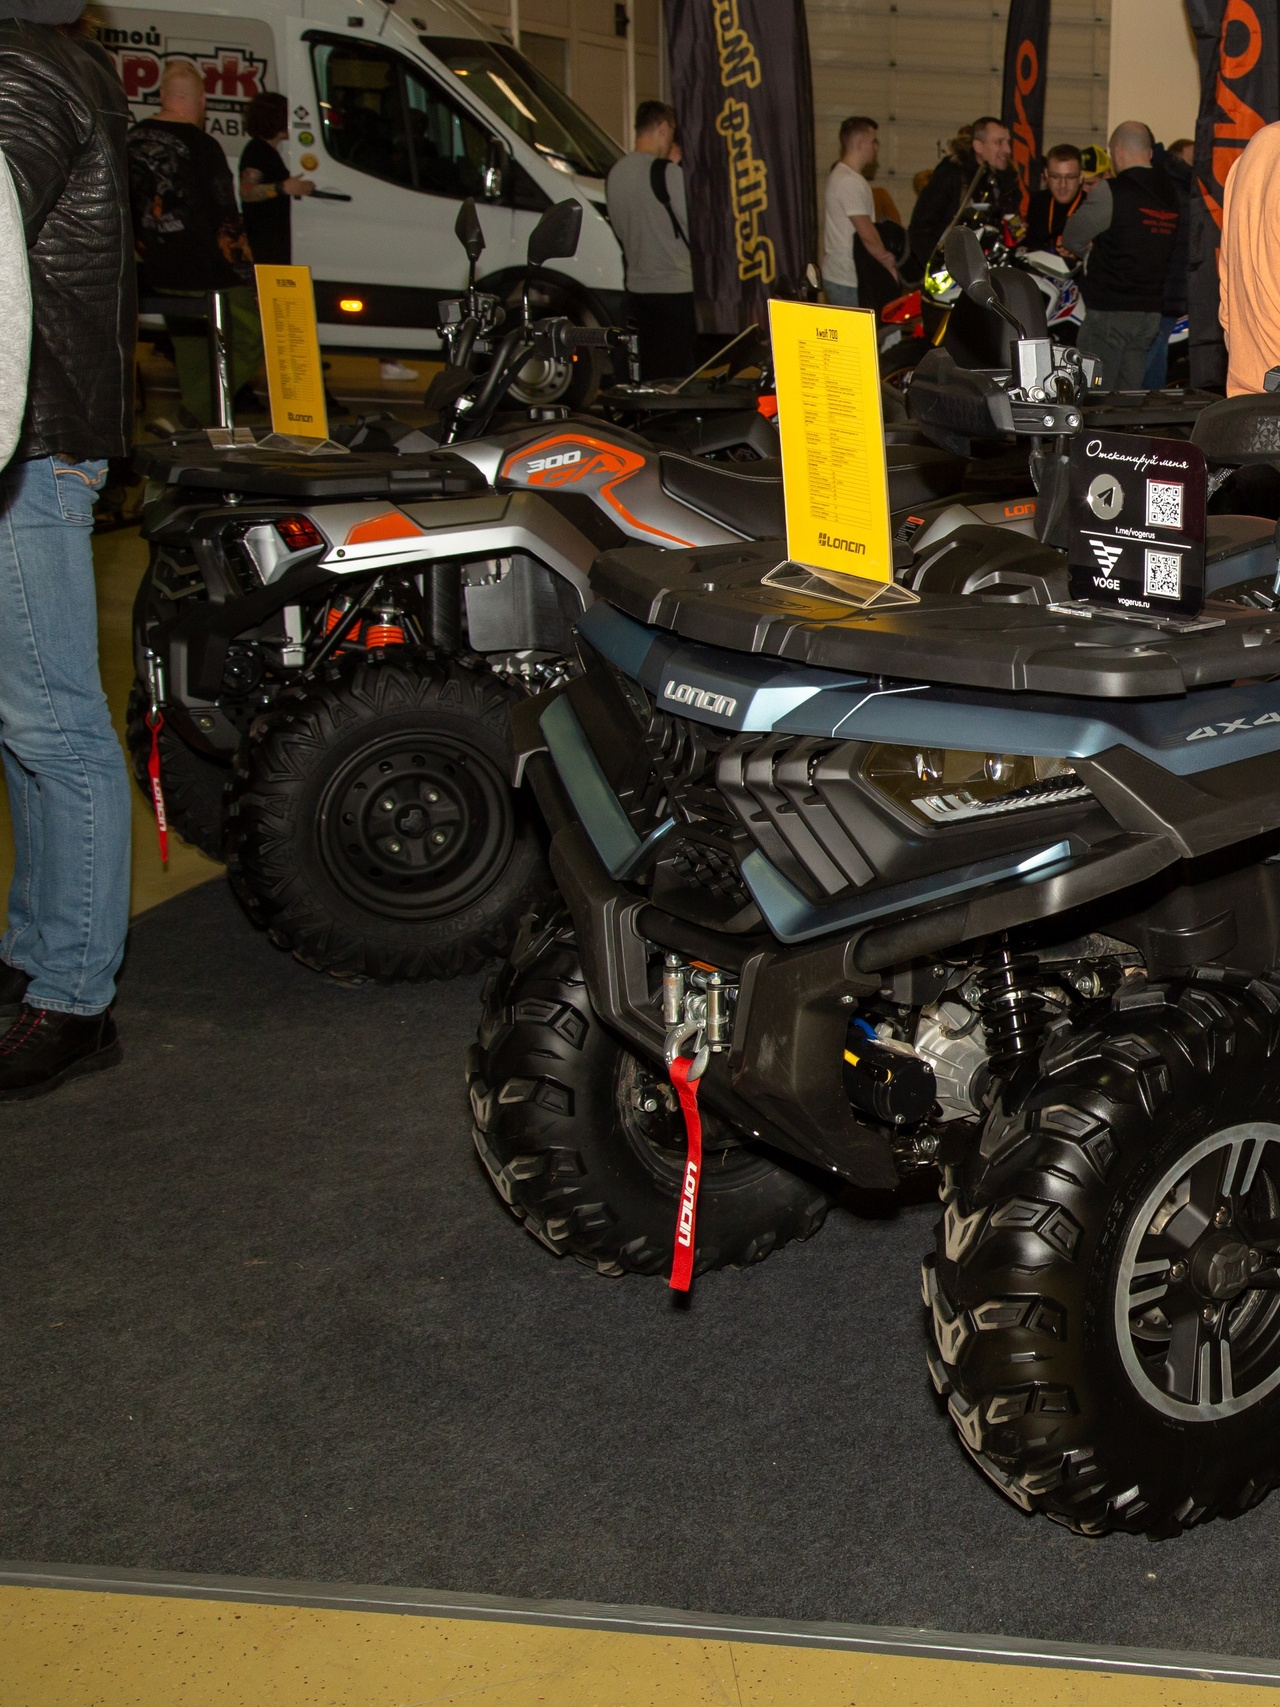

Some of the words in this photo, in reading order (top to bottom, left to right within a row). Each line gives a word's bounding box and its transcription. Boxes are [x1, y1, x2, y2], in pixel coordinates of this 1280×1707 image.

[526, 450, 581, 474] 300
[1086, 440, 1158, 472] Отсканируй
[1159, 459, 1189, 469] меня
[1005, 504, 1035, 517] LON
[1115, 526, 1156, 539] t.me/vogerus
[827, 536, 866, 555] LONCIN
[1092, 576, 1120, 590] VOGE
[1117, 597, 1150, 608] vogerus.ru
[664, 681, 737, 717] LONCIN
[153, 777, 167, 832] LONCIN
[678, 1161, 697, 1248] LONCIN
